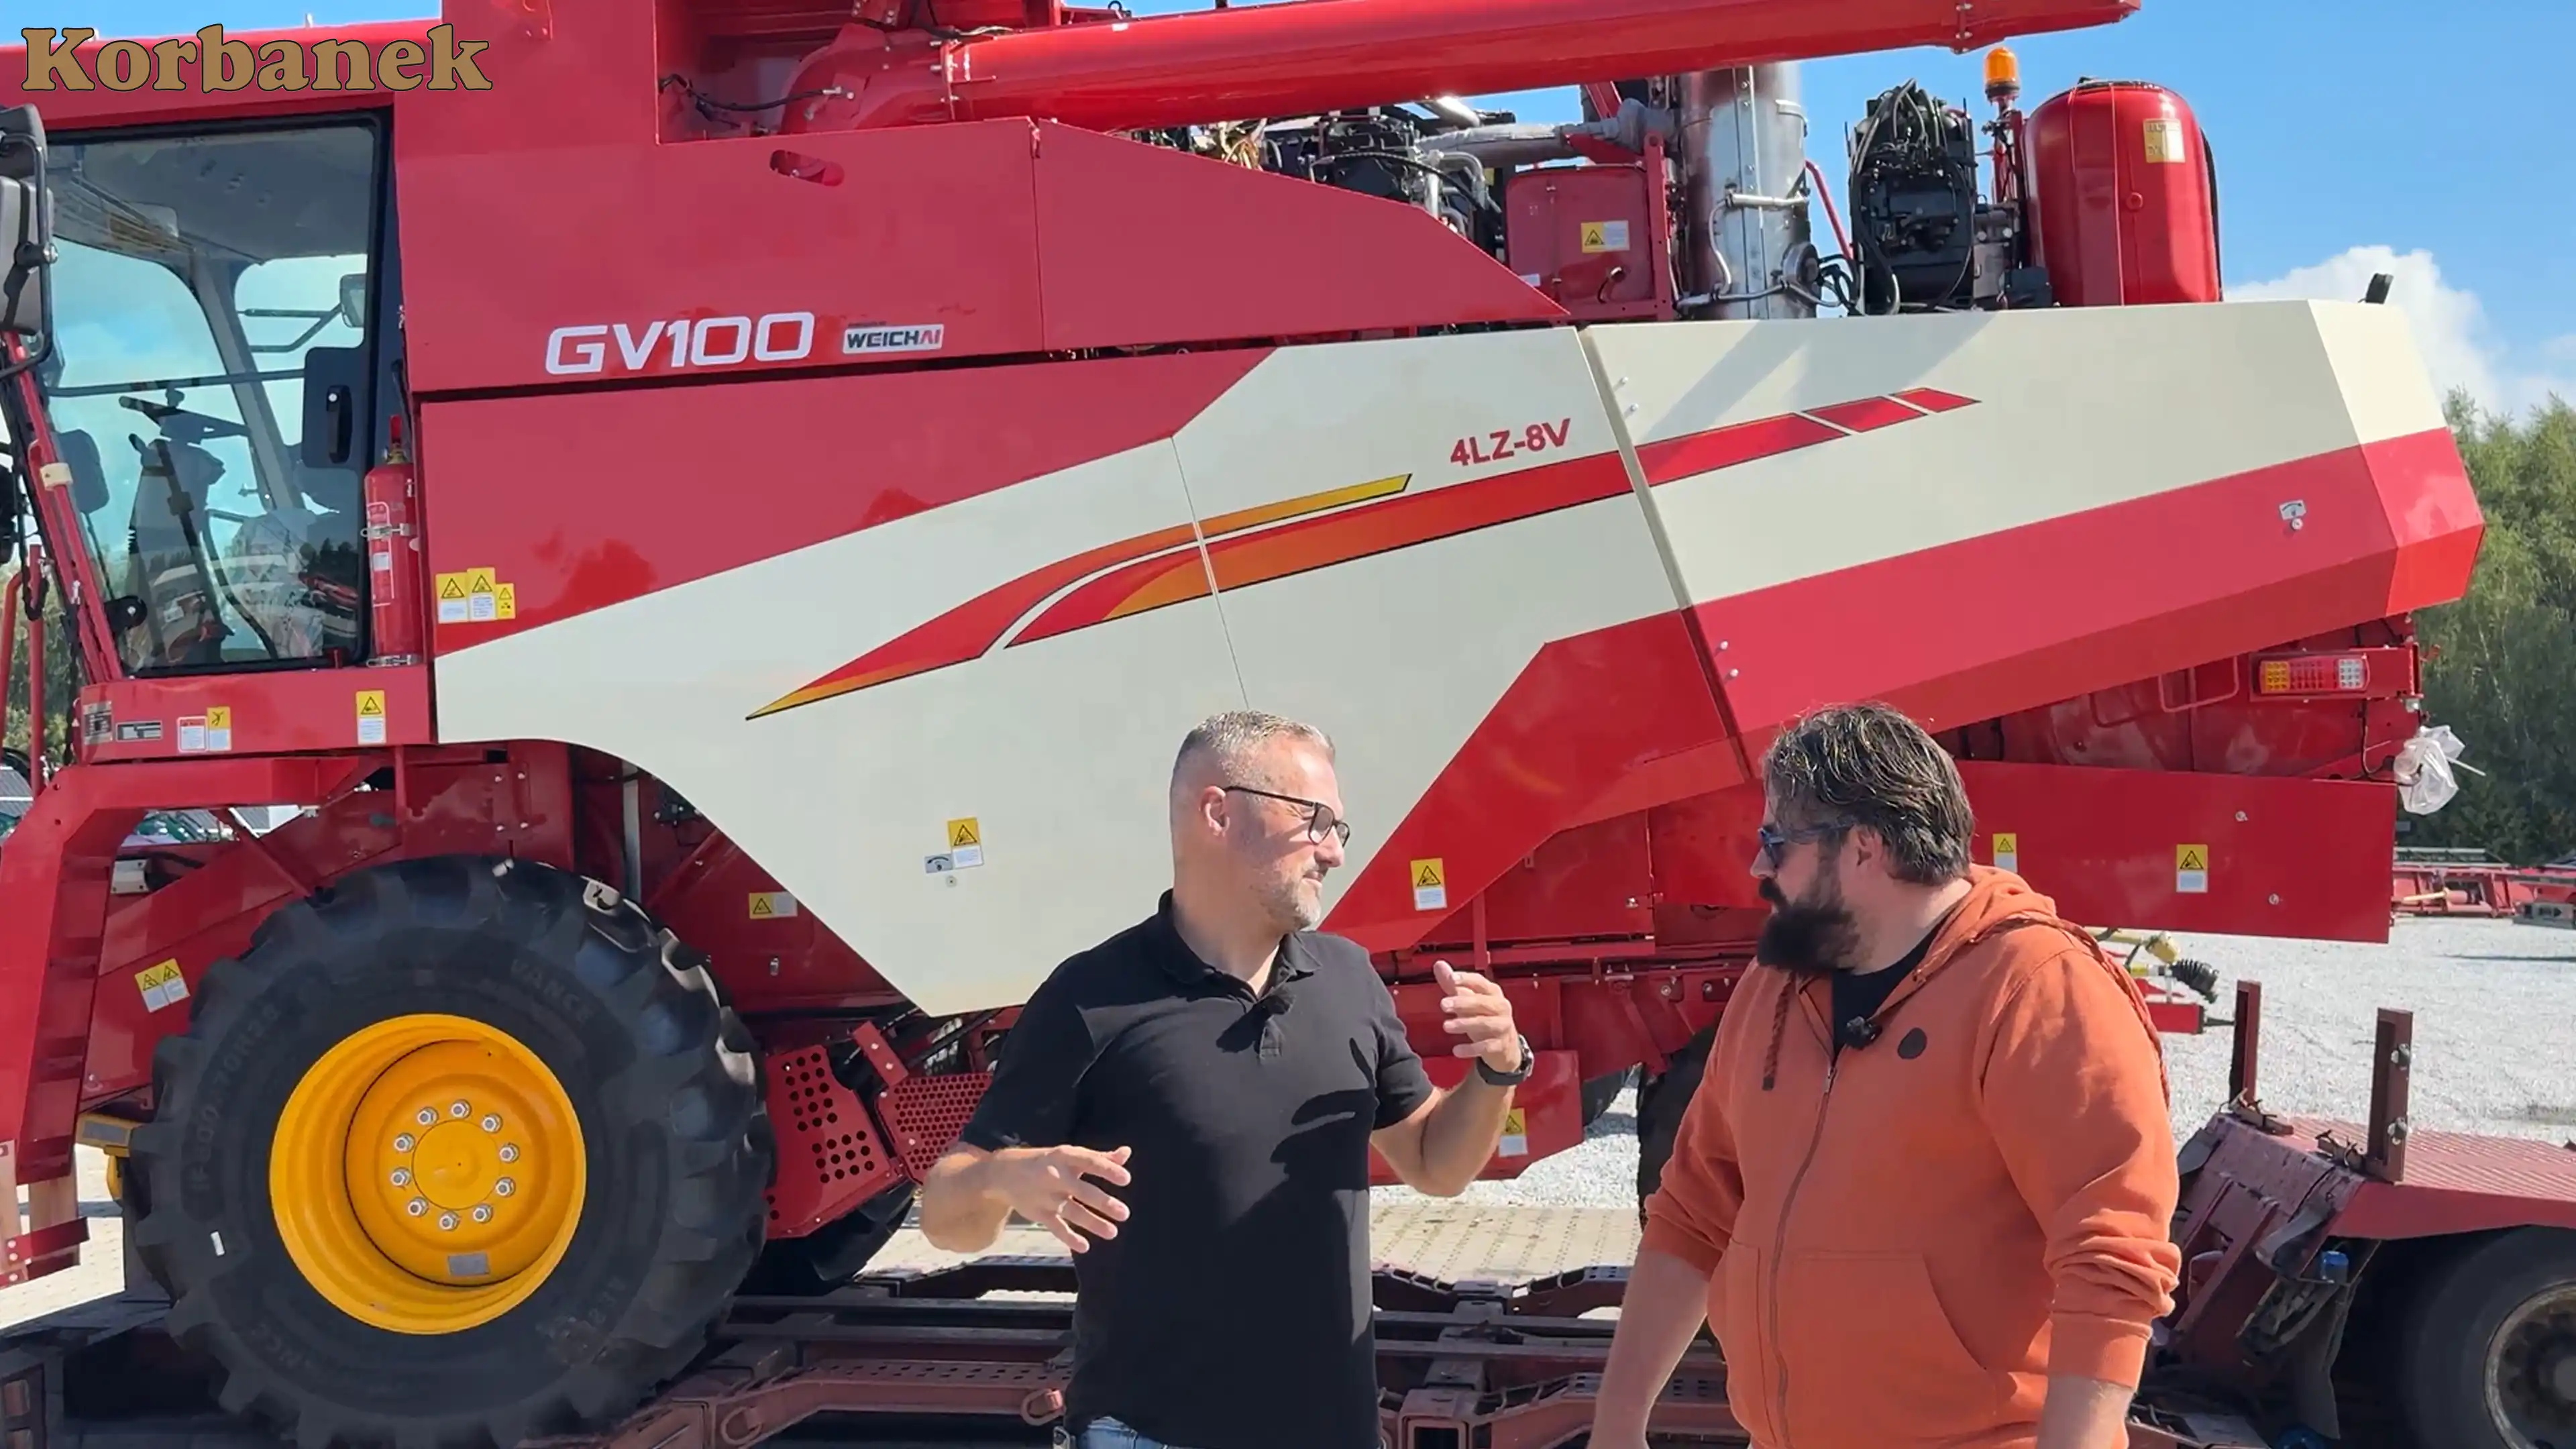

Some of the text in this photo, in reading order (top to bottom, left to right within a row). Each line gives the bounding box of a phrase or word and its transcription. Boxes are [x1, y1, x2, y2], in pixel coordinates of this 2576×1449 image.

[545, 311, 814, 375] GV100
[847, 329, 941, 348] WEICHAI
[1450, 418, 1570, 466] 4LZ-8V
